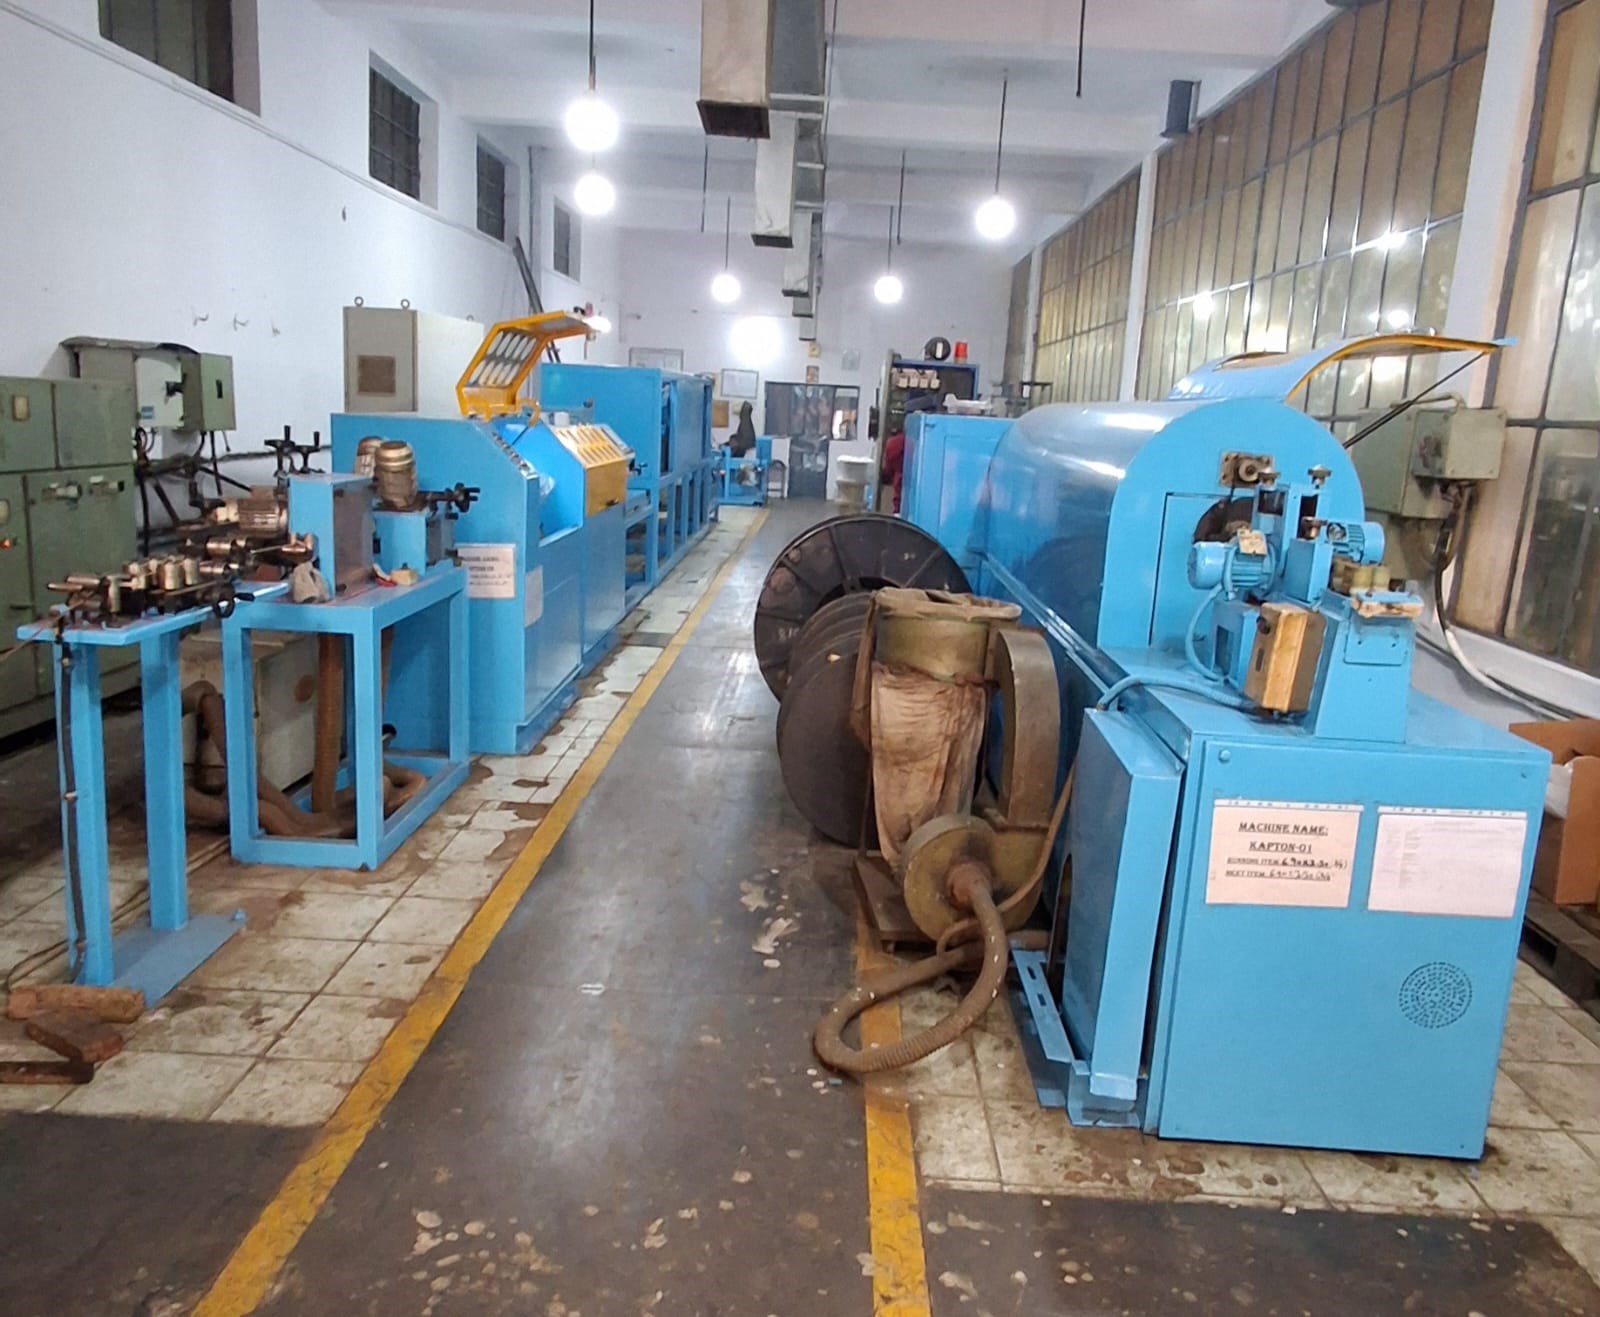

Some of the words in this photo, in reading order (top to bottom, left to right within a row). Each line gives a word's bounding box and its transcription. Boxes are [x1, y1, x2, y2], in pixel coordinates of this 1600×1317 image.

[1238, 822, 1289, 834] MACHINE
[1292, 824, 1329, 836] NAME:
[1249, 841, 1313, 854] KAPTON-01
